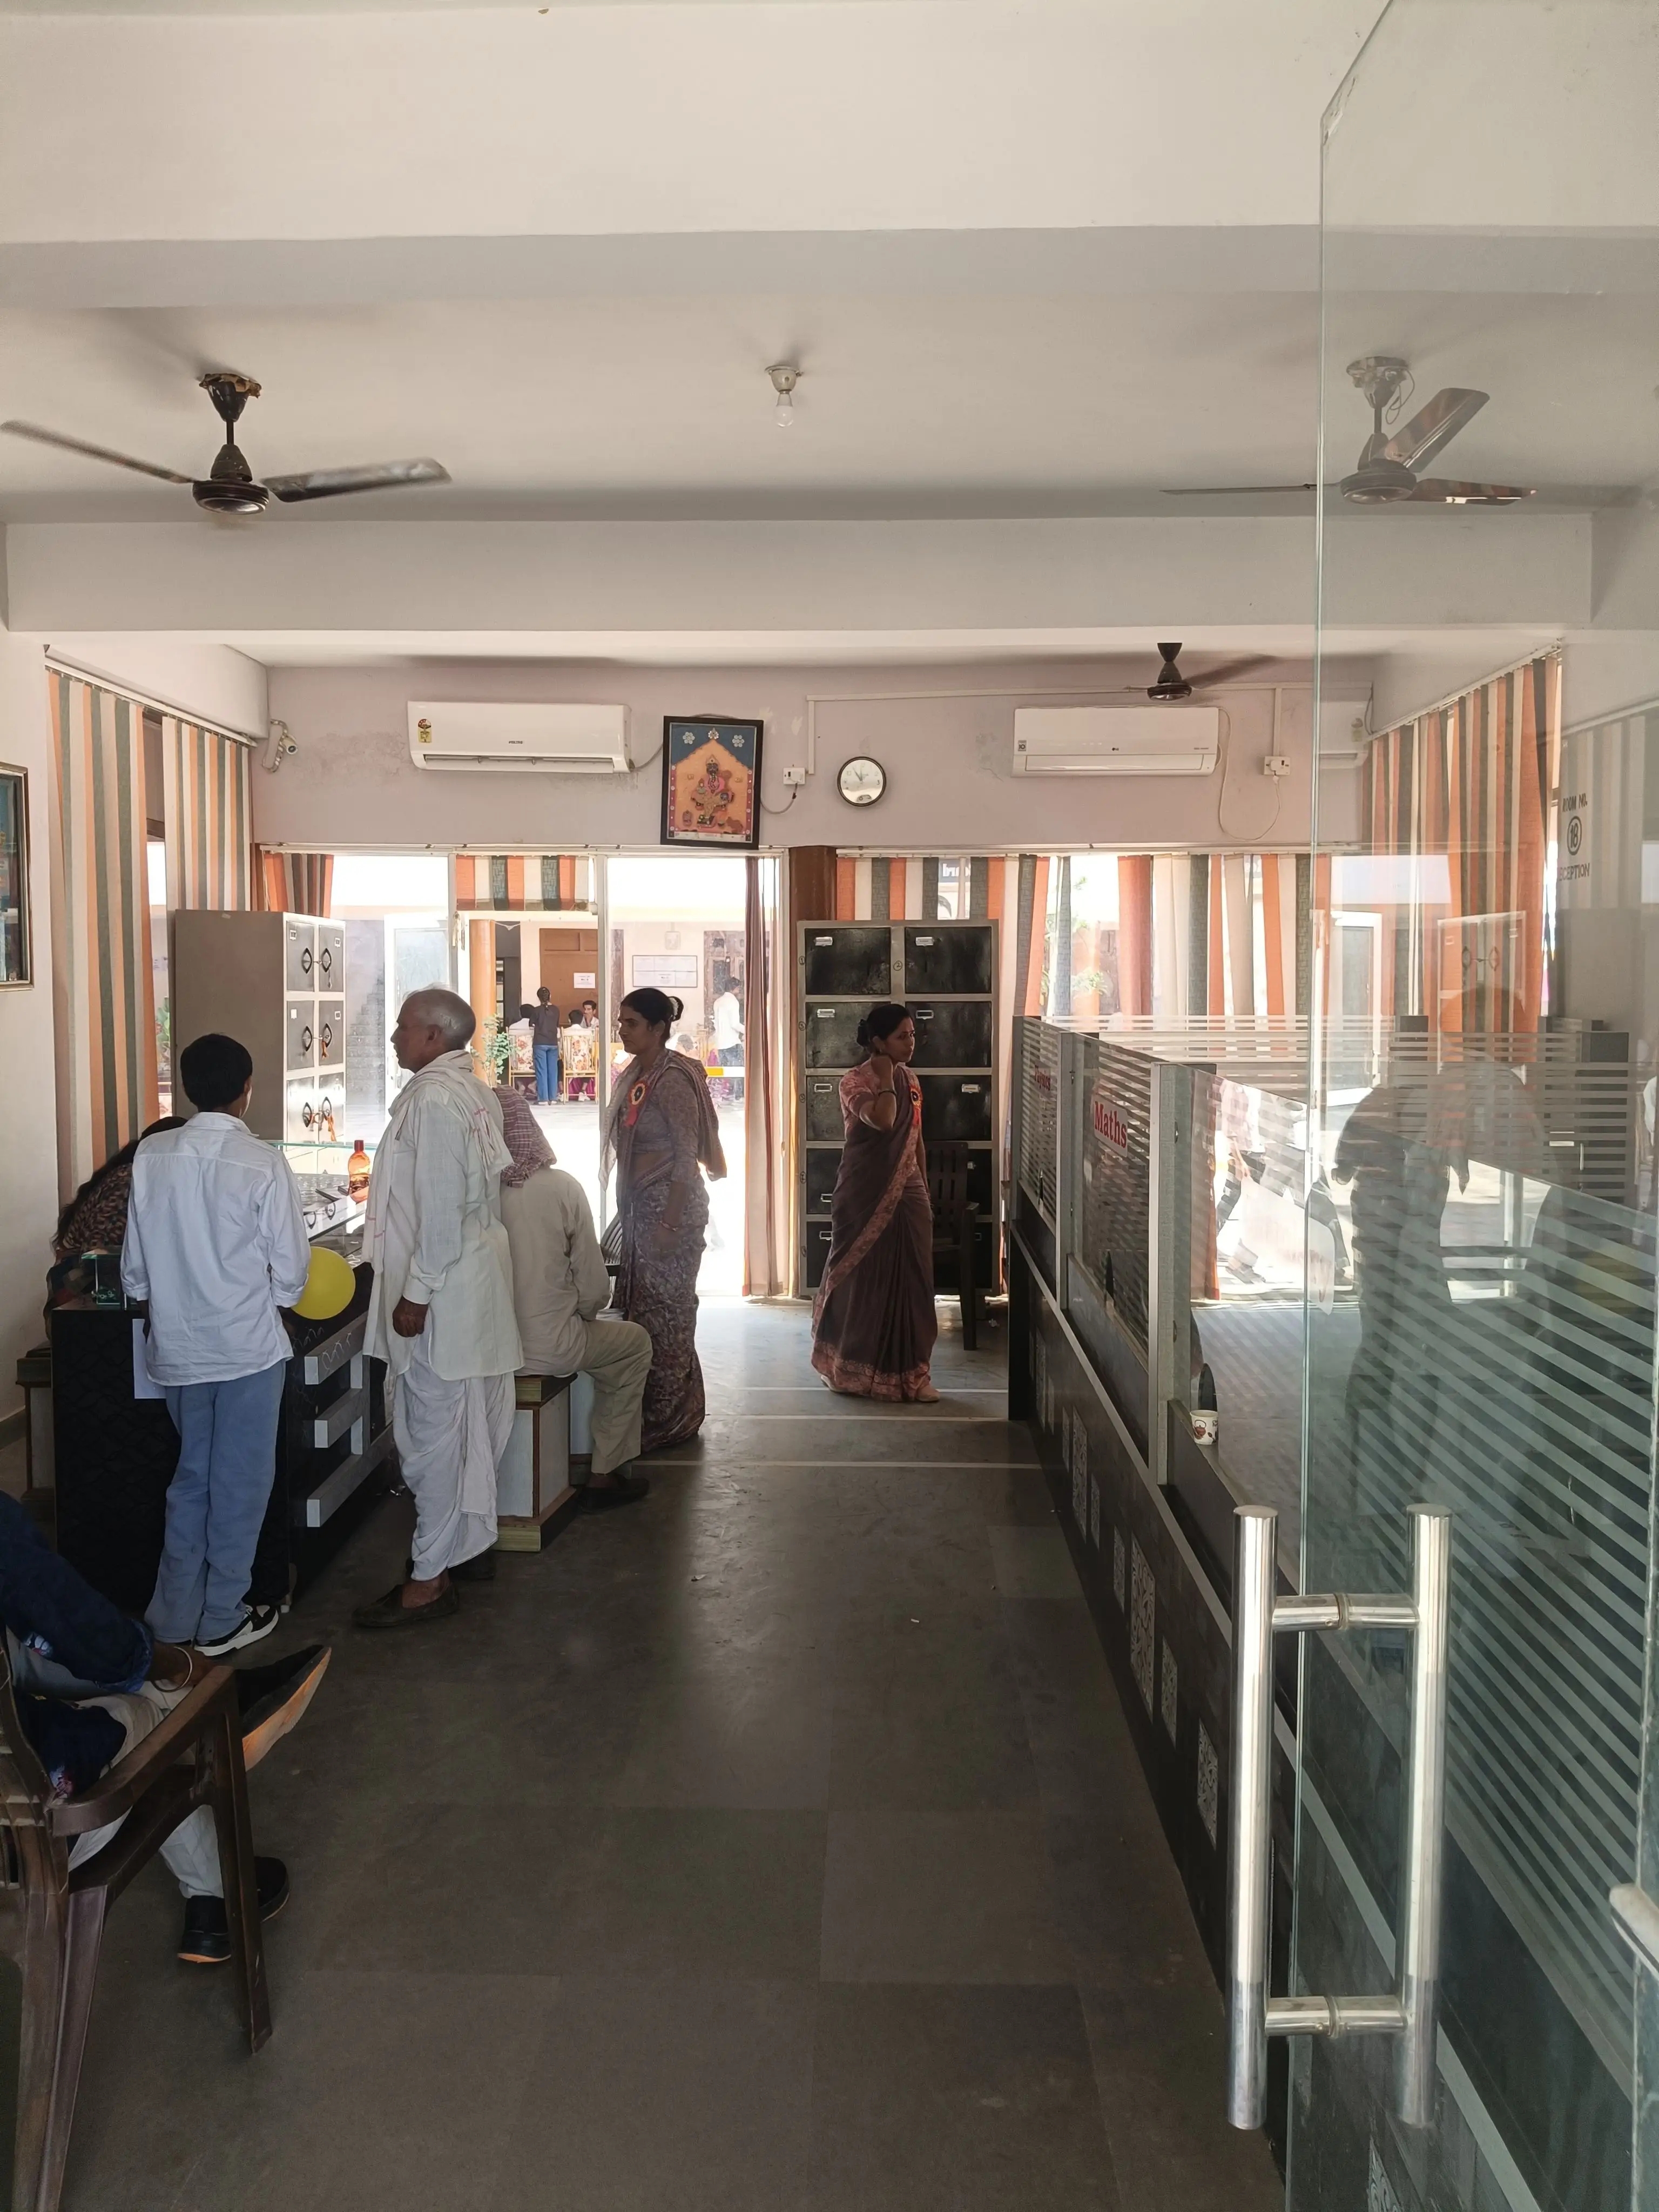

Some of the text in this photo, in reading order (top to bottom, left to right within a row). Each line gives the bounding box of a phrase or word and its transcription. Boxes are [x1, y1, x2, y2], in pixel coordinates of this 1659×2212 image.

[1562, 795, 1576, 812] ROOM
[1570, 822, 1579, 848] 18
[1558, 863, 1590, 881] ECEPTION
[1035, 1064, 1051, 1091] Physics
[1095, 1101, 1127, 1149] Maths
